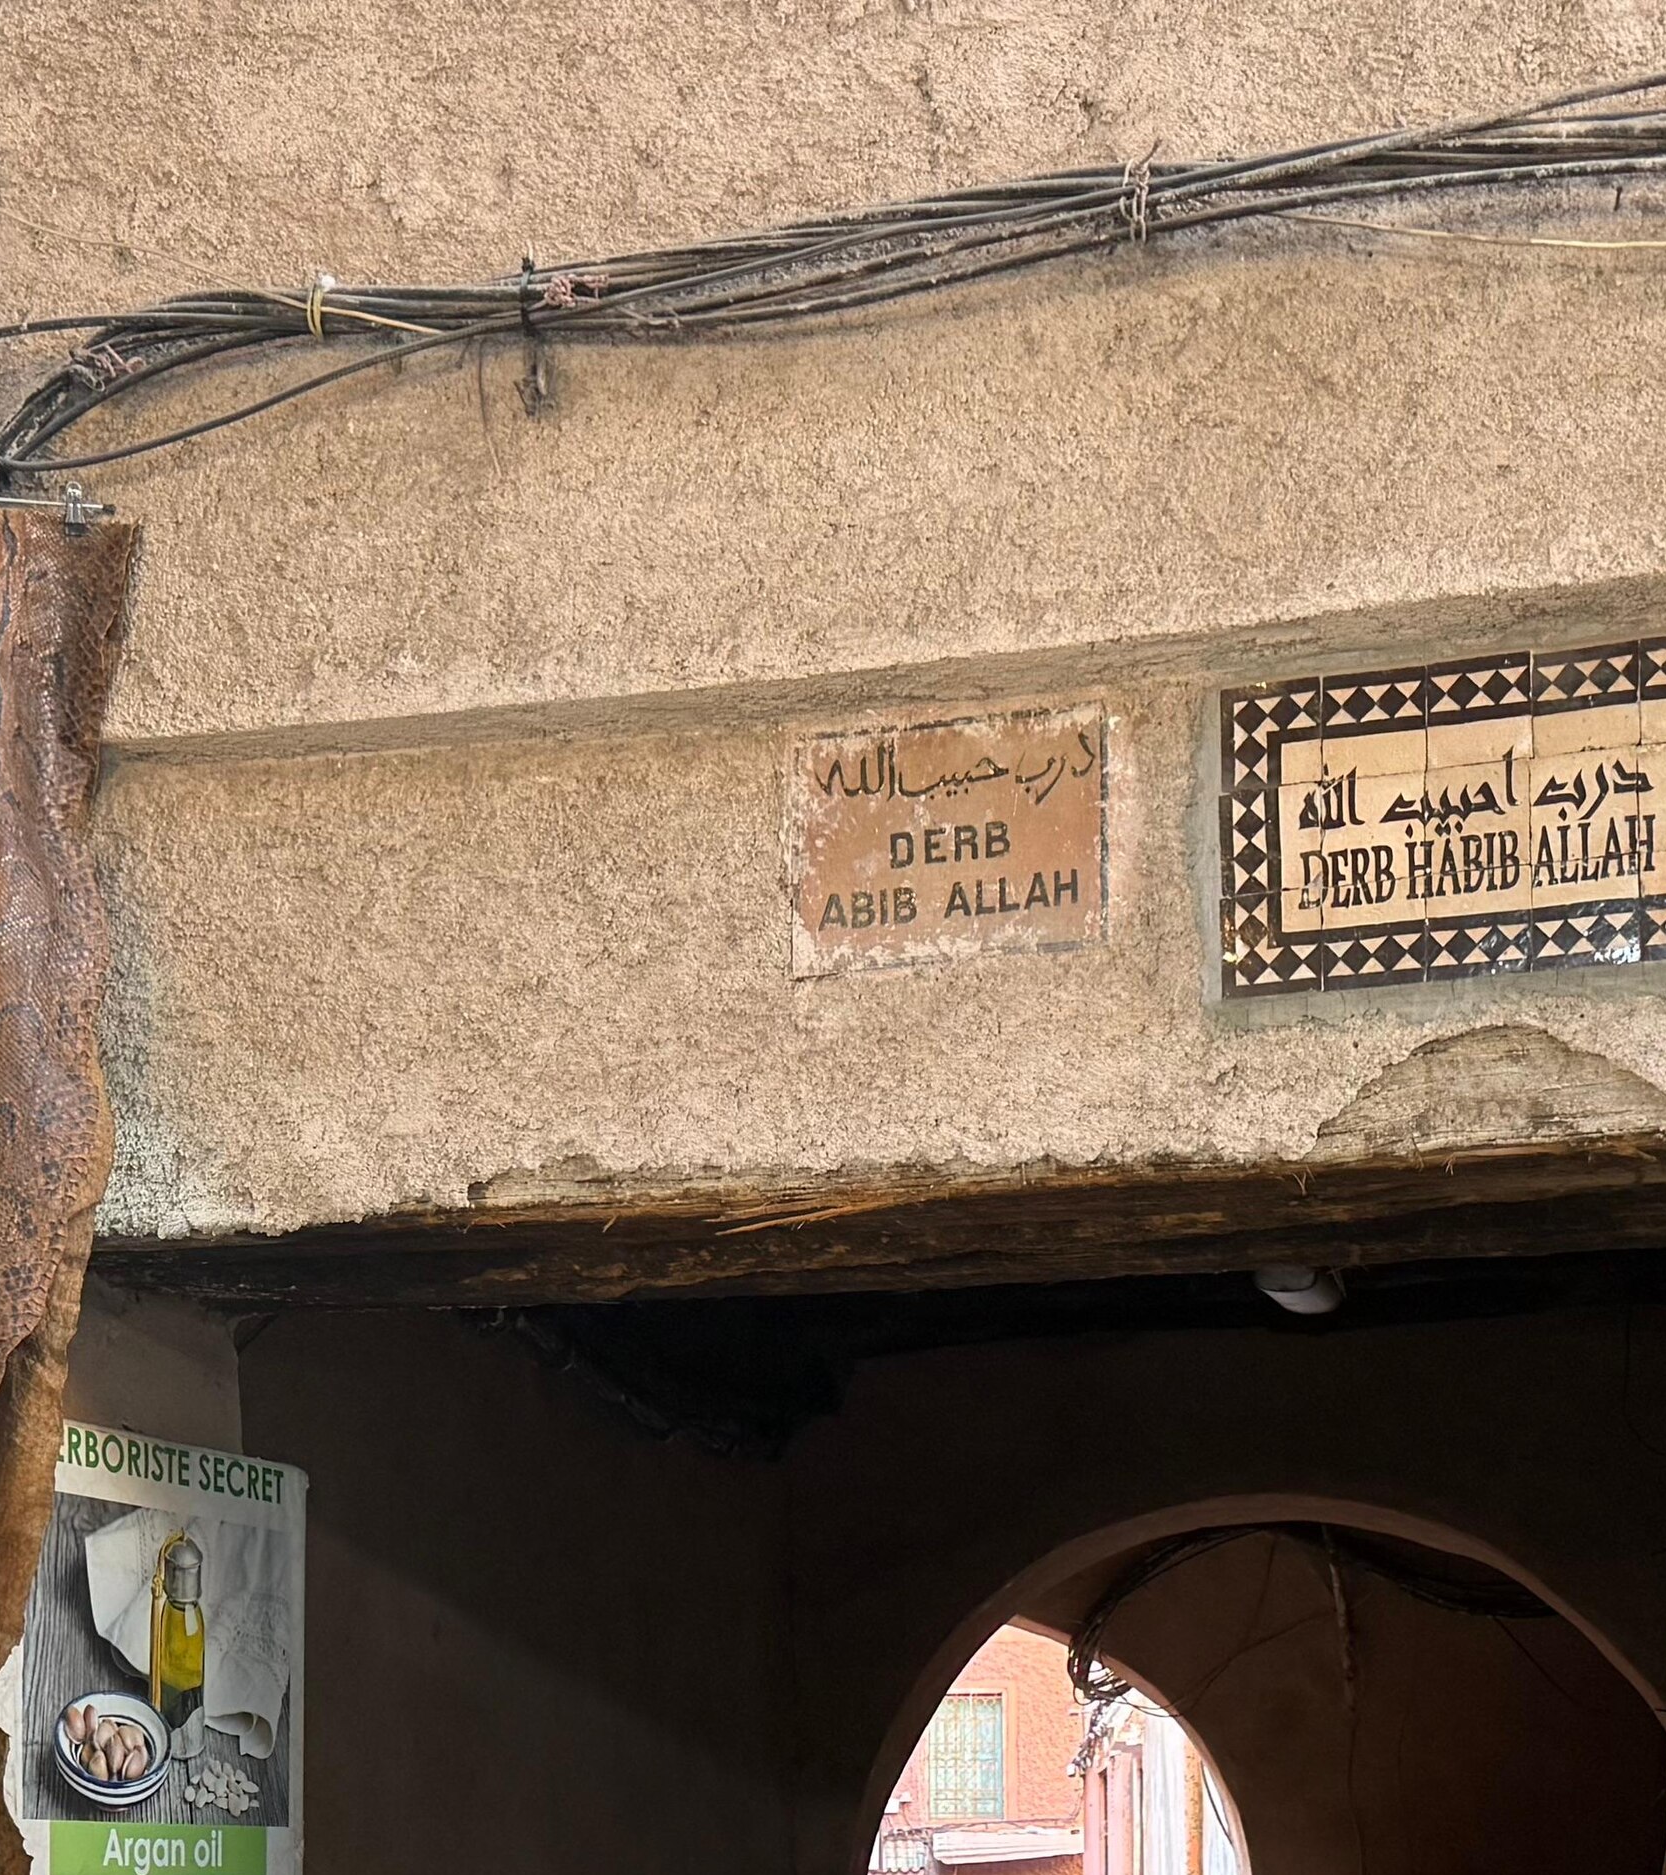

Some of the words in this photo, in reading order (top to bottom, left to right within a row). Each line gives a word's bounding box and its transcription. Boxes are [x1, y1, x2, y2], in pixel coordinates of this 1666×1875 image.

[813, 736, 897, 802] الله
[1014, 731, 1096, 806] درب
[1298, 762, 1366, 830] الله
[1534, 759, 1655, 822] درب
[889, 820, 1012, 869] DERB
[1298, 845, 1397, 910] DERB
[1404, 828, 1521, 900] HABIB
[1534, 813, 1657, 889] ALLAH
[817, 886, 918, 932] ABIB
[944, 868, 1079, 919] ALLAH
[58, 1426, 190, 1488] RBORISTE
[199, 1453, 285, 1505] SECRET
[194, 1829, 223, 1868] oil
